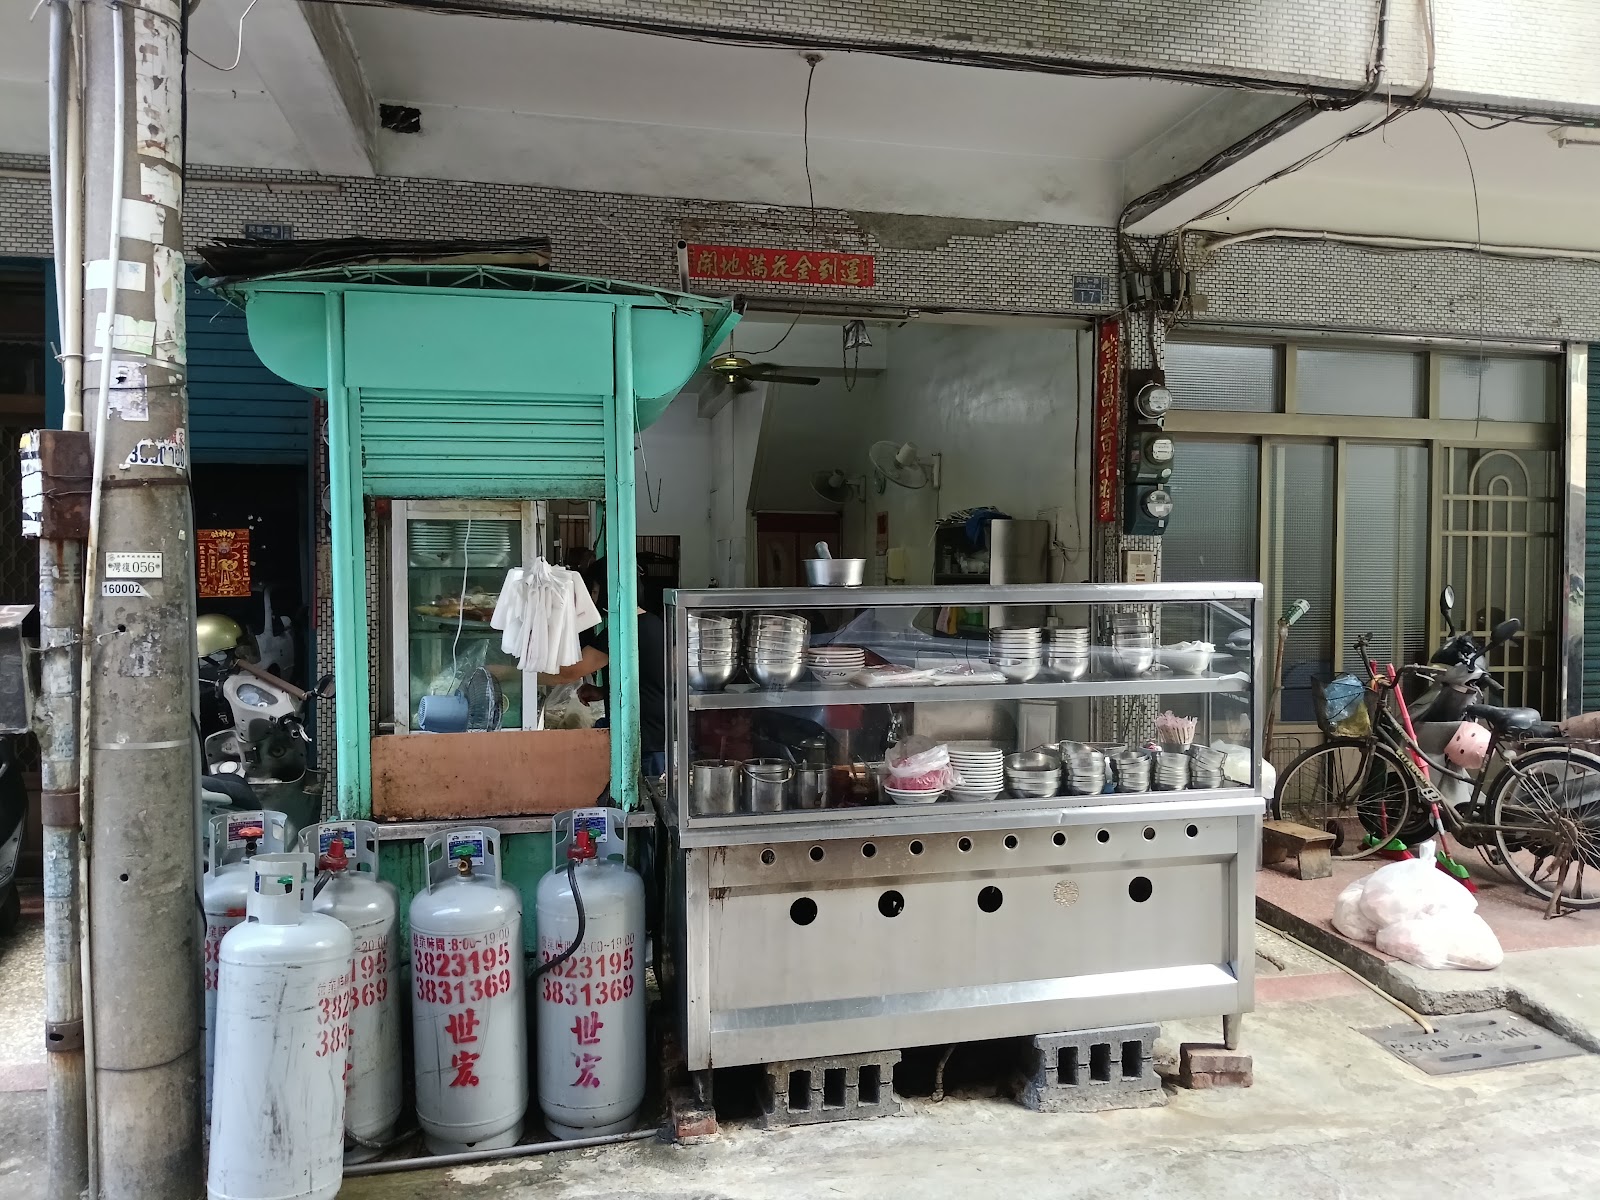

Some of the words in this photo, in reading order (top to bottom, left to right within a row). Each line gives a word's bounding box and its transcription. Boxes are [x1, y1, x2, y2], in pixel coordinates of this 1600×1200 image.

[1081, 291, 1095, 302] 17
[103, 583, 142, 594] 160002
[415, 941, 510, 977] 3823195
[416, 969, 511, 1004] 3831369
[542, 974, 634, 1006] 3831369
